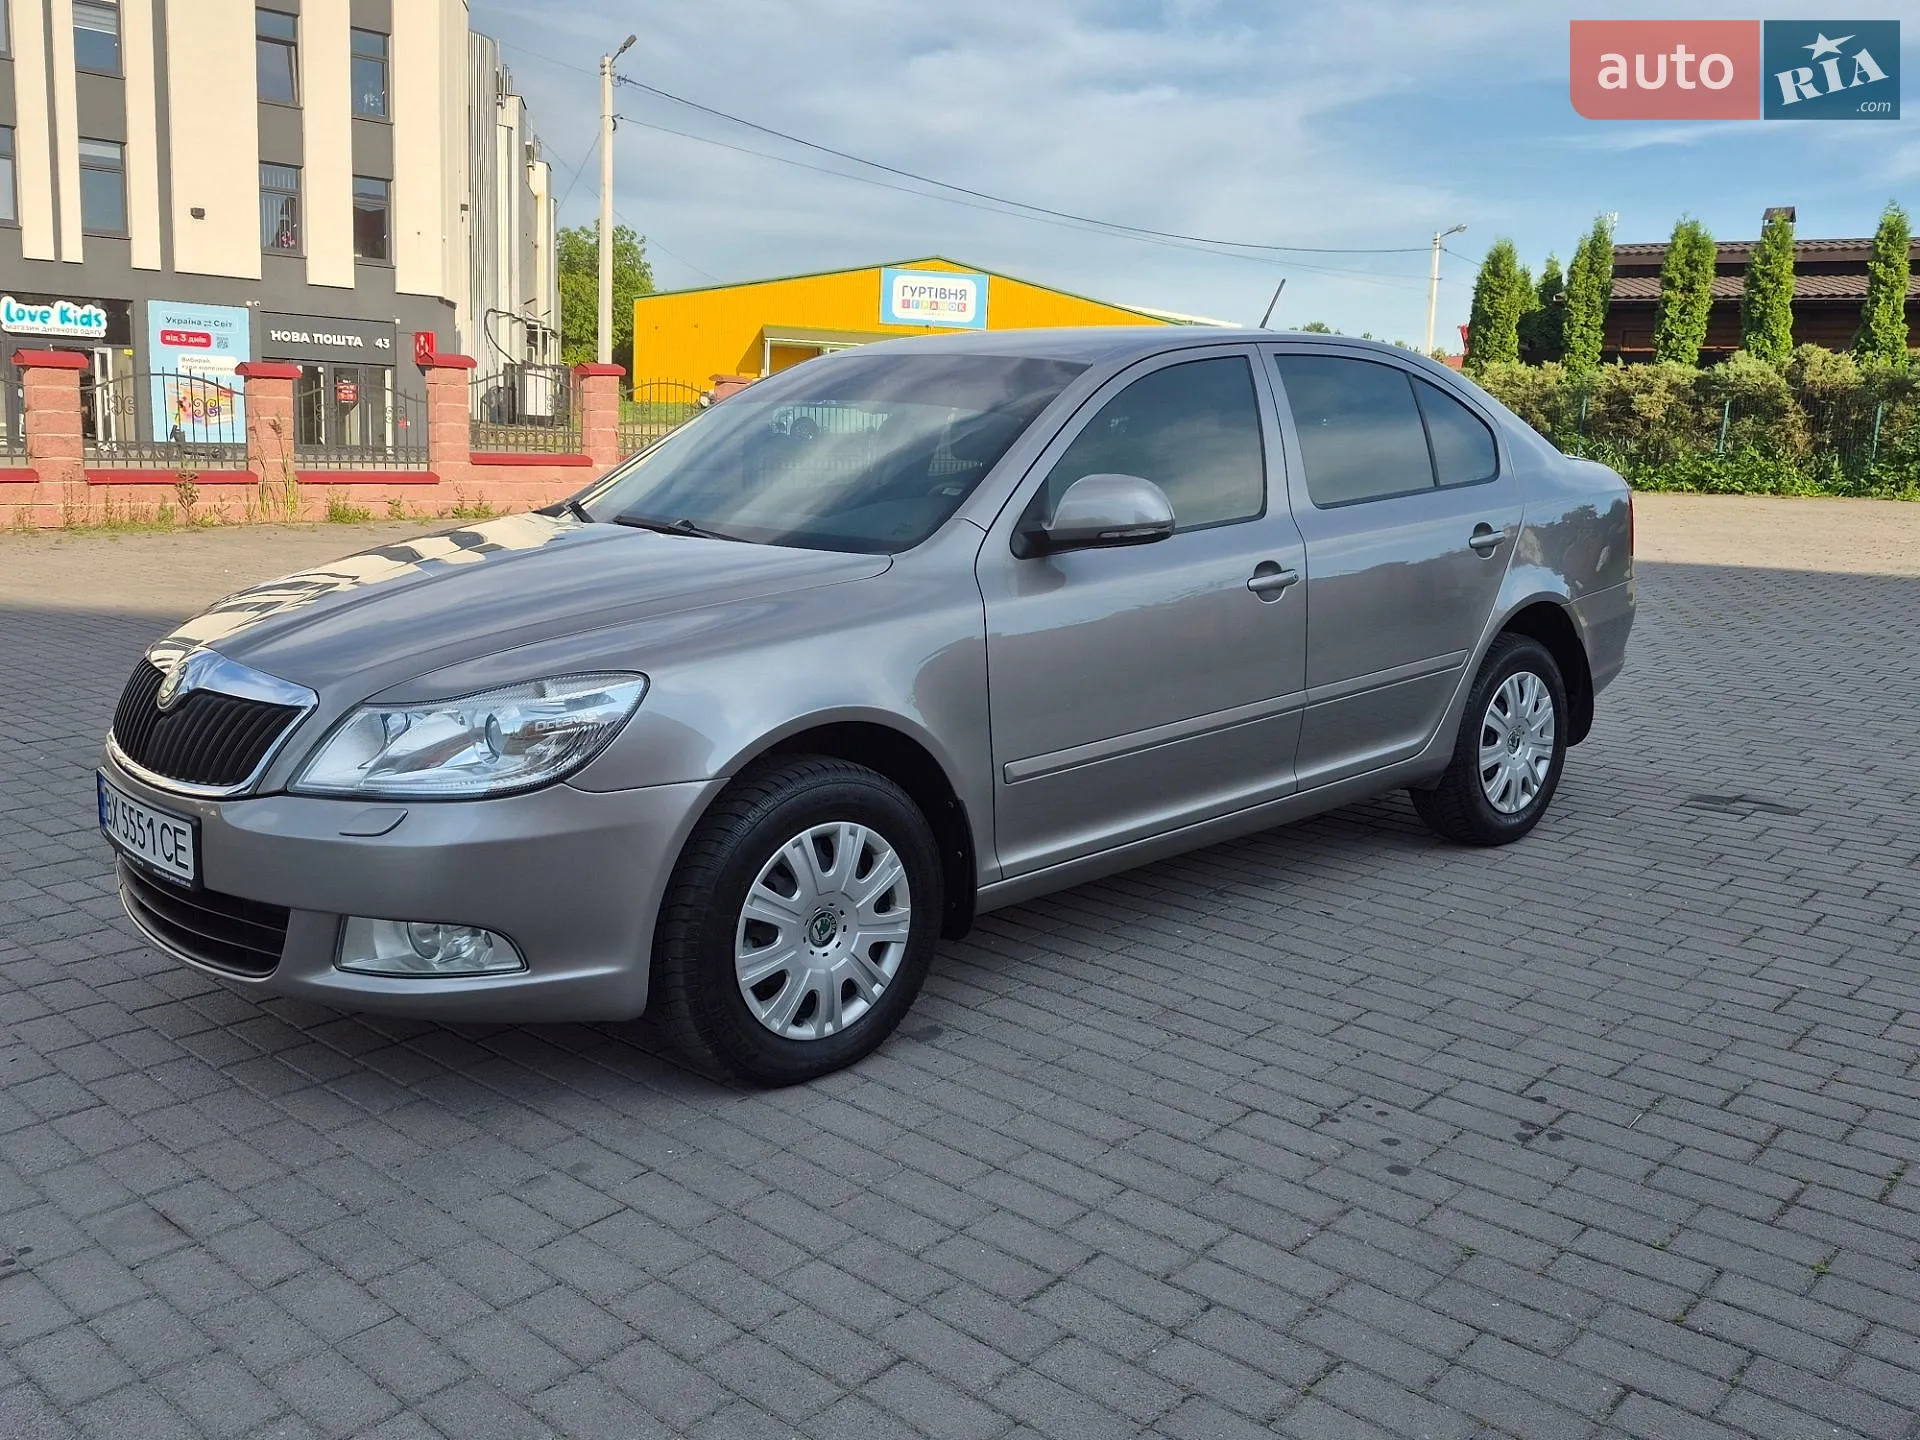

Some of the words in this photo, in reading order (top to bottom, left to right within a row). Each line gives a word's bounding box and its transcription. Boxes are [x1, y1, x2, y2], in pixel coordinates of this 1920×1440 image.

[902, 285, 967, 301] ГУРТІВНЯ
[5, 301, 52, 325] Love
[60, 305, 103, 328] Kids
[165, 316, 202, 326] Україна
[213, 320, 233, 328] Світ
[270, 329, 311, 344] НОВА
[312, 332, 363, 348] ПОШТА
[375, 337, 390, 349] 43
[121, 801, 156, 856] 5551
[160, 822, 189, 871] CE
